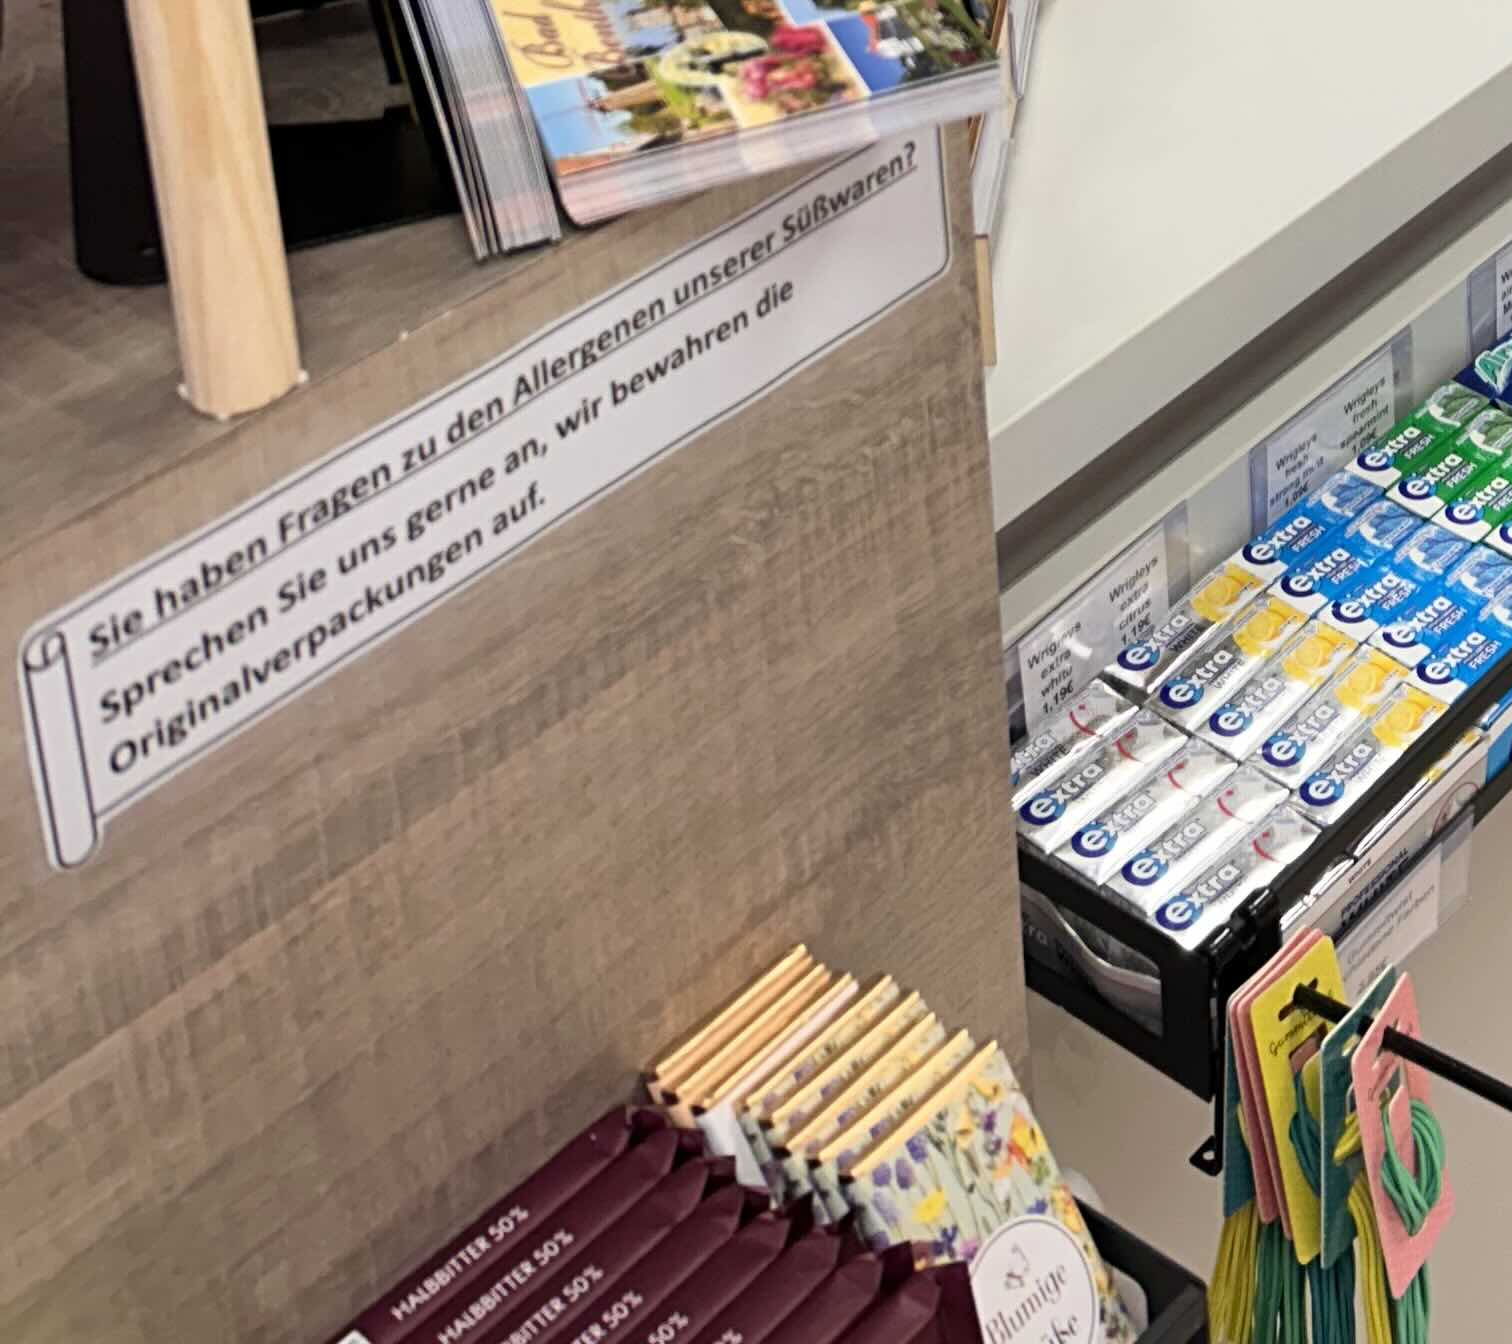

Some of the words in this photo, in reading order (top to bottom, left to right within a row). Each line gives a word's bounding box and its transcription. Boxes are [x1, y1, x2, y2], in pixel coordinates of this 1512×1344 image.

[89, 609, 143, 656] Sie
[154, 535, 268, 617] haben
[277, 465, 392, 544] Fragen
[401, 436, 439, 472] zu
[447, 397, 504, 445] den
[512, 296, 665, 406] Allergenen
[674, 231, 775, 307] unserer
[782, 142, 917, 243] Süßwaren?
[100, 606, 269, 724] Sprechen
[277, 565, 328, 613] Sie
[338, 527, 397, 576] uns
[406, 463, 495, 542] gerne
[504, 435, 550, 475] an,
[555, 398, 602, 440] wir
[610, 309, 750, 408] bewahren
[755, 277, 795, 319] die
[1453, 478, 1510, 520] extra
[1118, 599, 1153, 631] citrus
[1119, 586, 1151, 611] extra
[108, 530, 484, 775] Originalverpackungen
[492, 480, 546, 537] auf.
[1170, 649, 1234, 703] extra
[1425, 632, 1486, 681] extra
[1466, 640, 1502, 669] FRESH
[1165, 863, 1241, 922] extra
[391, 1234, 492, 1322] HALBBITTER
[488, 1205, 529, 1242] 50%
[533, 1228, 574, 1266] 50%
